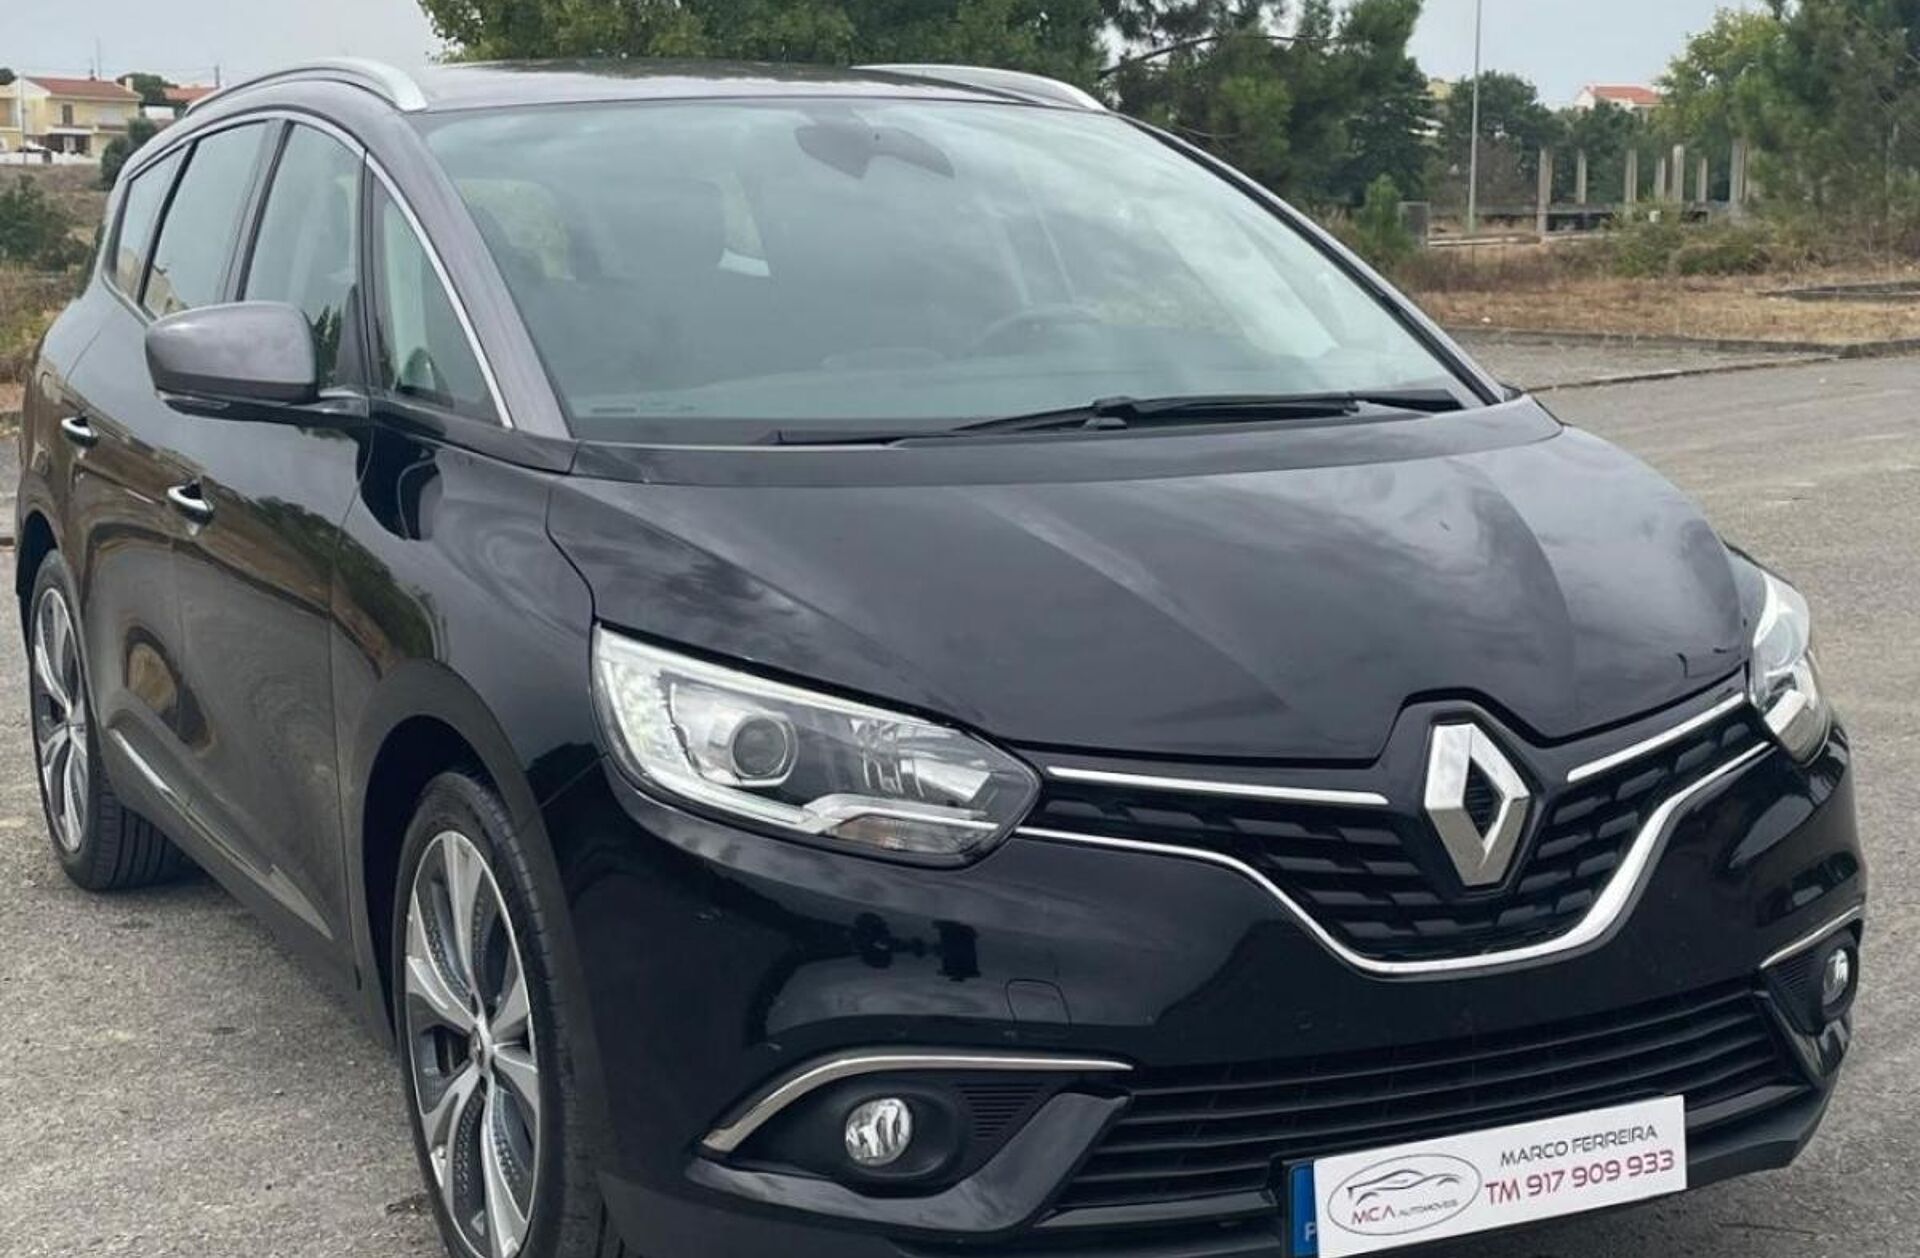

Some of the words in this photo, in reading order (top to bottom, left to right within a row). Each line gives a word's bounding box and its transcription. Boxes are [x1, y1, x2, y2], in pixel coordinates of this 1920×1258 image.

[1500, 1140, 1569, 1166] MARCO
[1572, 1125, 1658, 1153] FERREIRA
[1485, 1179, 1520, 1204] TM
[1527, 1170, 1566, 1197] 917
[1571, 1160, 1621, 1188] 909
[1627, 1150, 1675, 1177] 933
[1351, 1205, 1396, 1225] MCA
